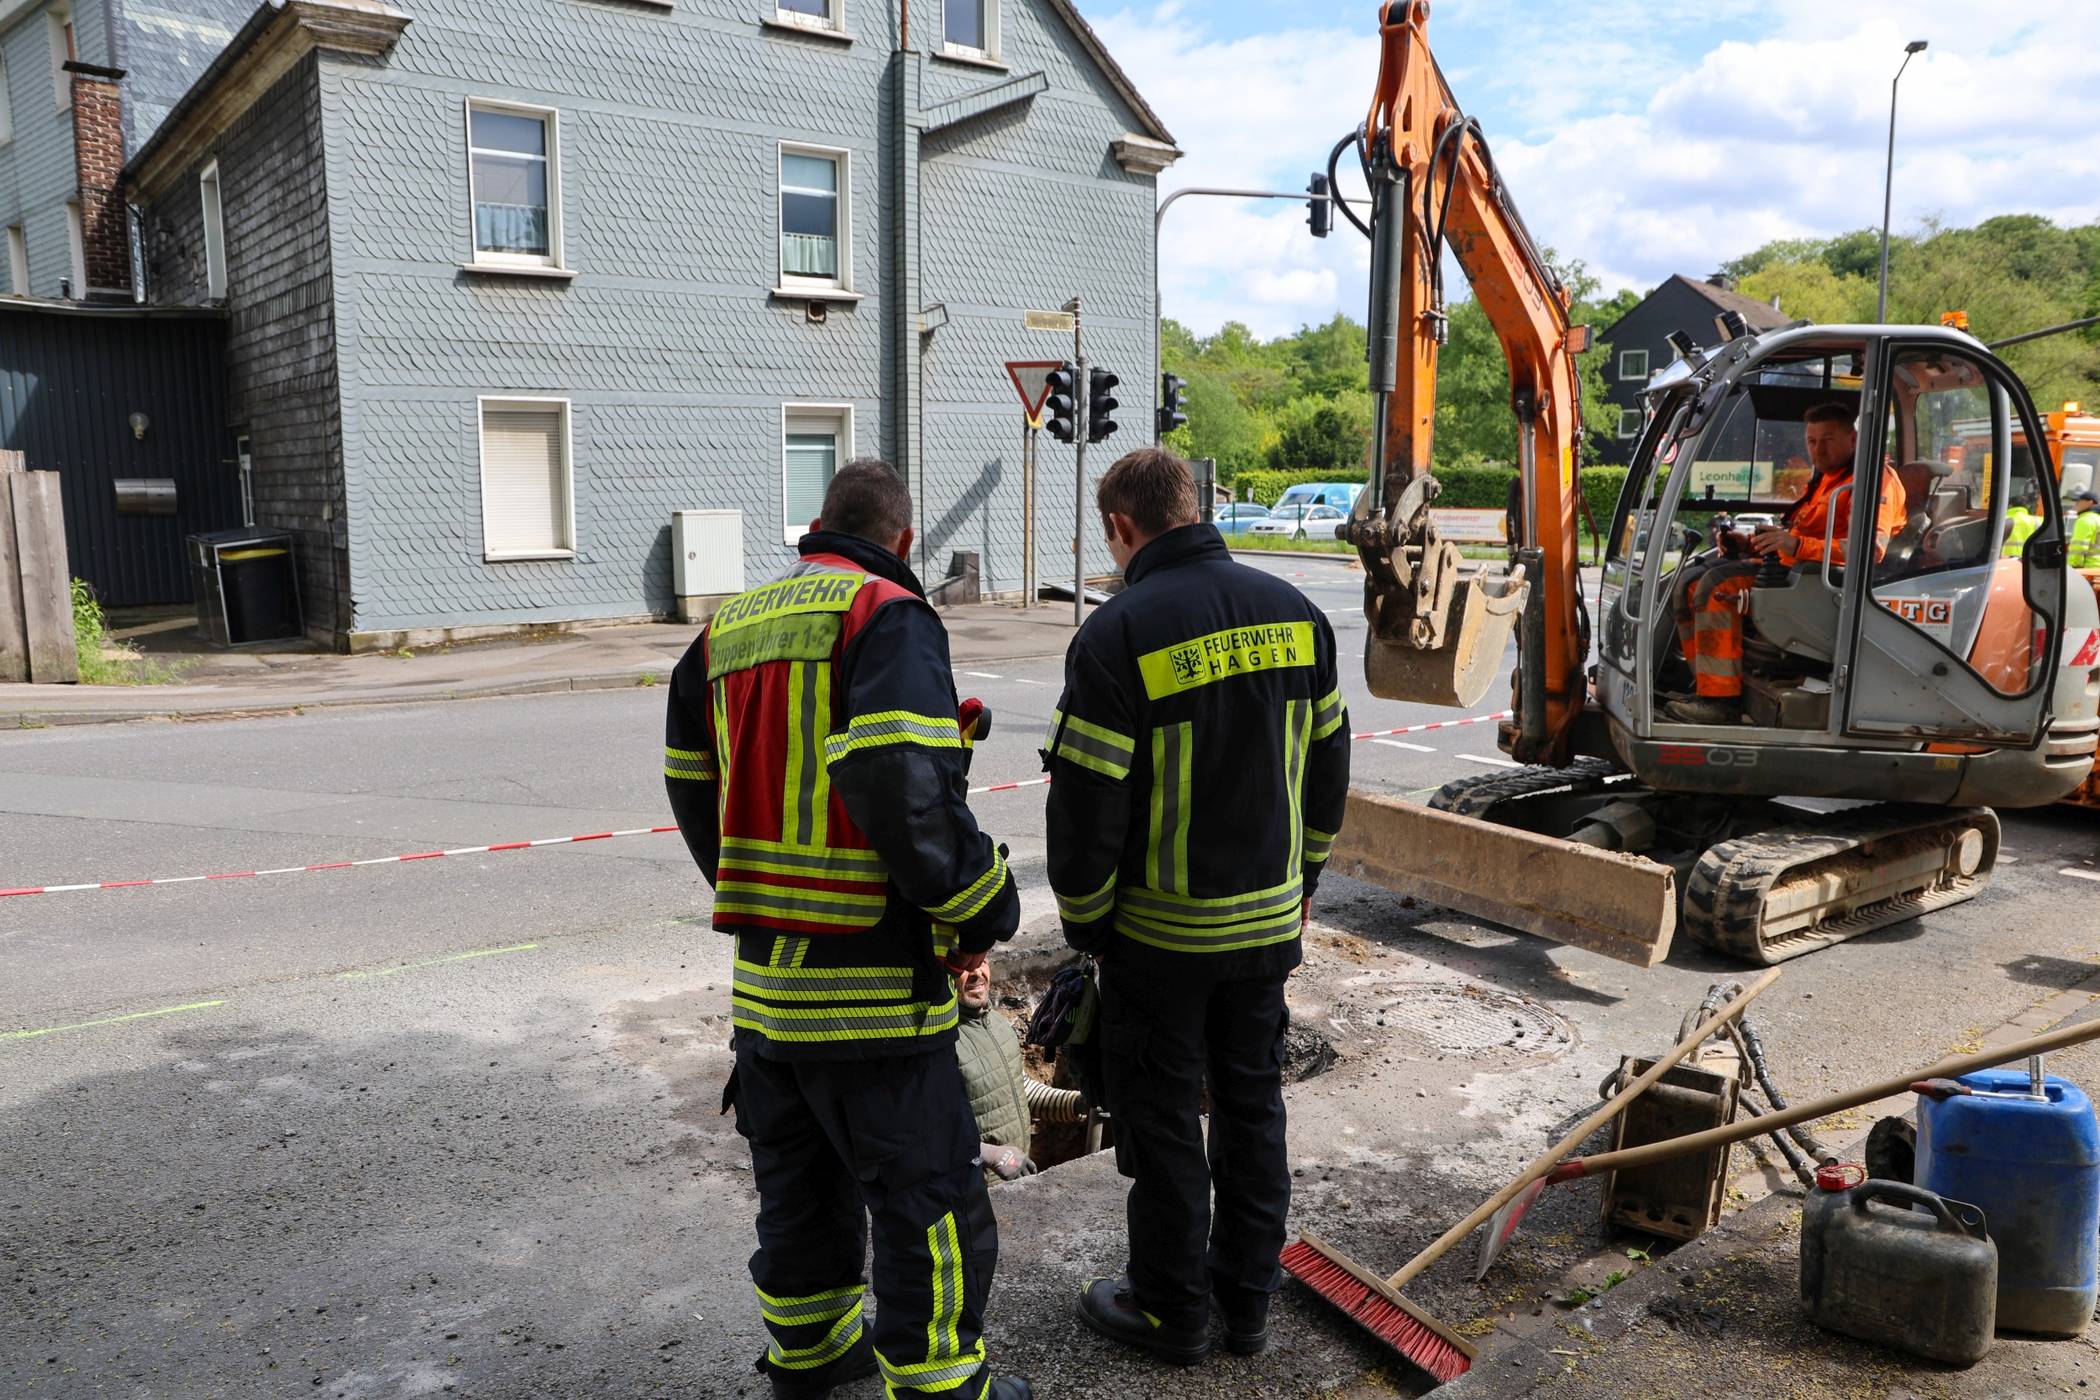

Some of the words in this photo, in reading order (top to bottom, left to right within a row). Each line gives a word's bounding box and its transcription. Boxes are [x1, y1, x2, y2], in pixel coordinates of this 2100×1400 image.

[715, 578, 855, 630] FEUERWEHR
[1880, 601, 1947, 622] TG
[1203, 626, 1295, 657] FEUERWEHR
[1209, 647, 1297, 676] HAGEN
